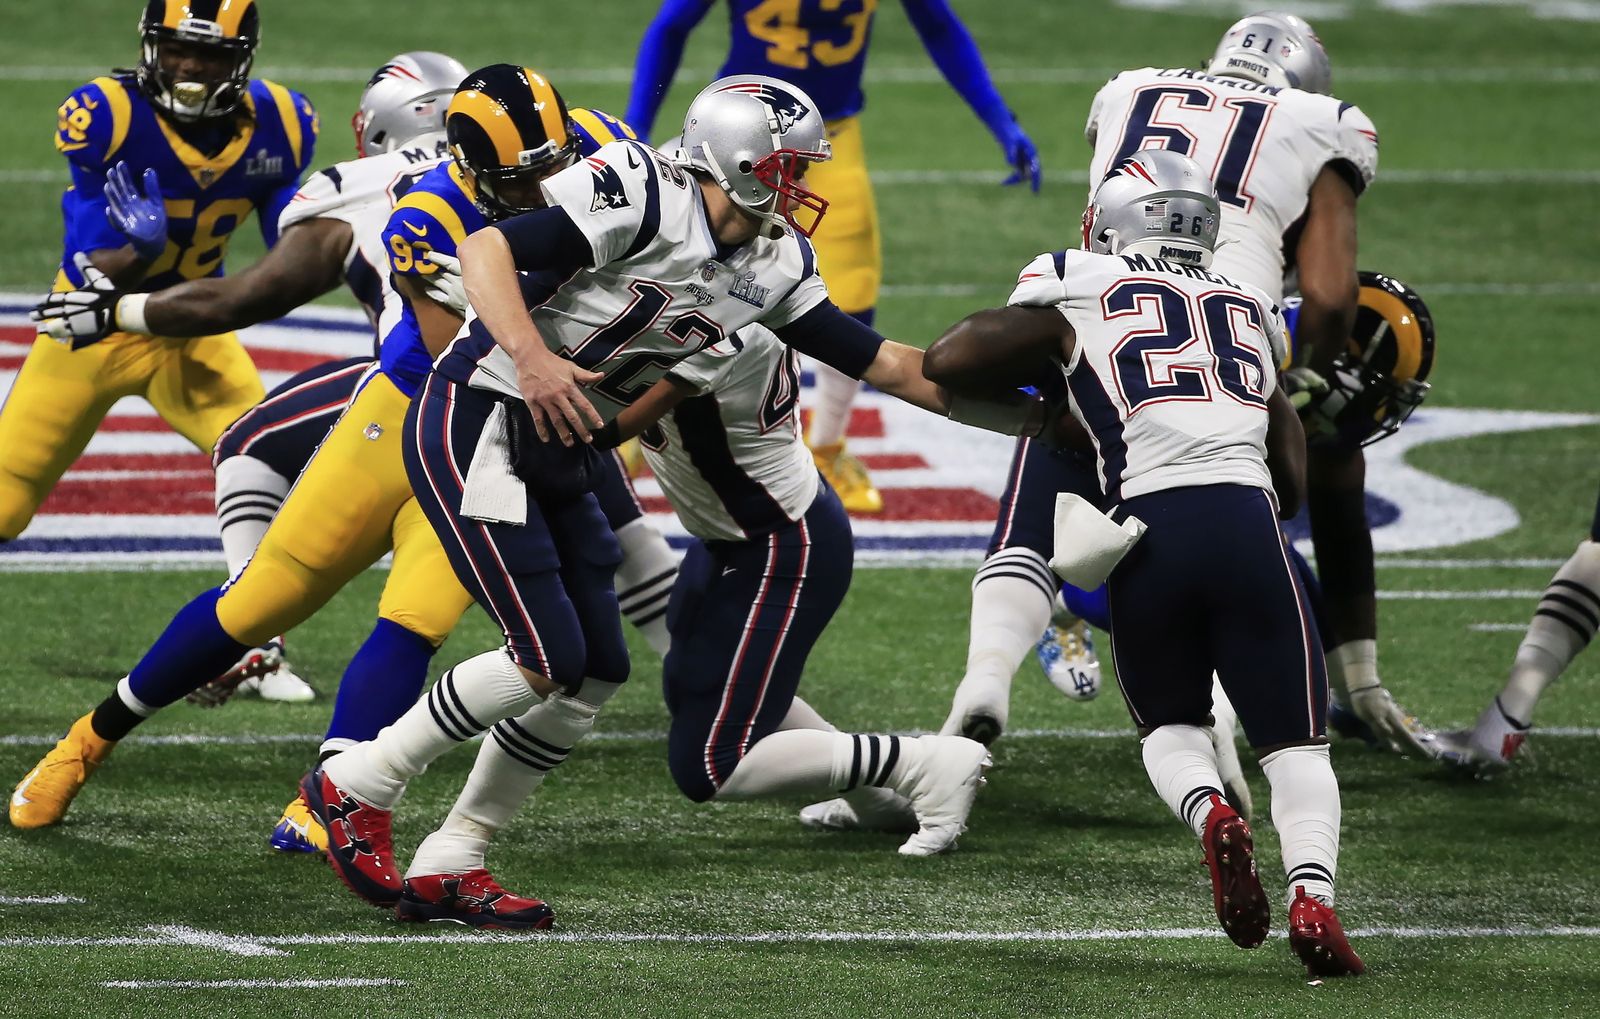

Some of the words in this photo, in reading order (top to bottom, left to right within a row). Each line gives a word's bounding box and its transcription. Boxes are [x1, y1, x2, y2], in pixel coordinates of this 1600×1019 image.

[744, 0, 877, 69] 43
[1242, 34, 1273, 53] 61
[1226, 58, 1269, 77] PATRIOTS
[402, 141, 448, 164] MA
[1104, 84, 1277, 214] 61
[654, 156, 687, 190] 2
[147, 198, 253, 280] 58
[1170, 213, 1202, 236] 26
[390, 234, 438, 275] 93
[1159, 246, 1203, 262] PATRIOTS
[1120, 253, 1241, 290] MICHEL
[684, 283, 715, 305] PATRIOTS
[558, 279, 725, 406] 12
[1100, 277, 1269, 418] 26
[1068, 667, 1095, 696] LA
